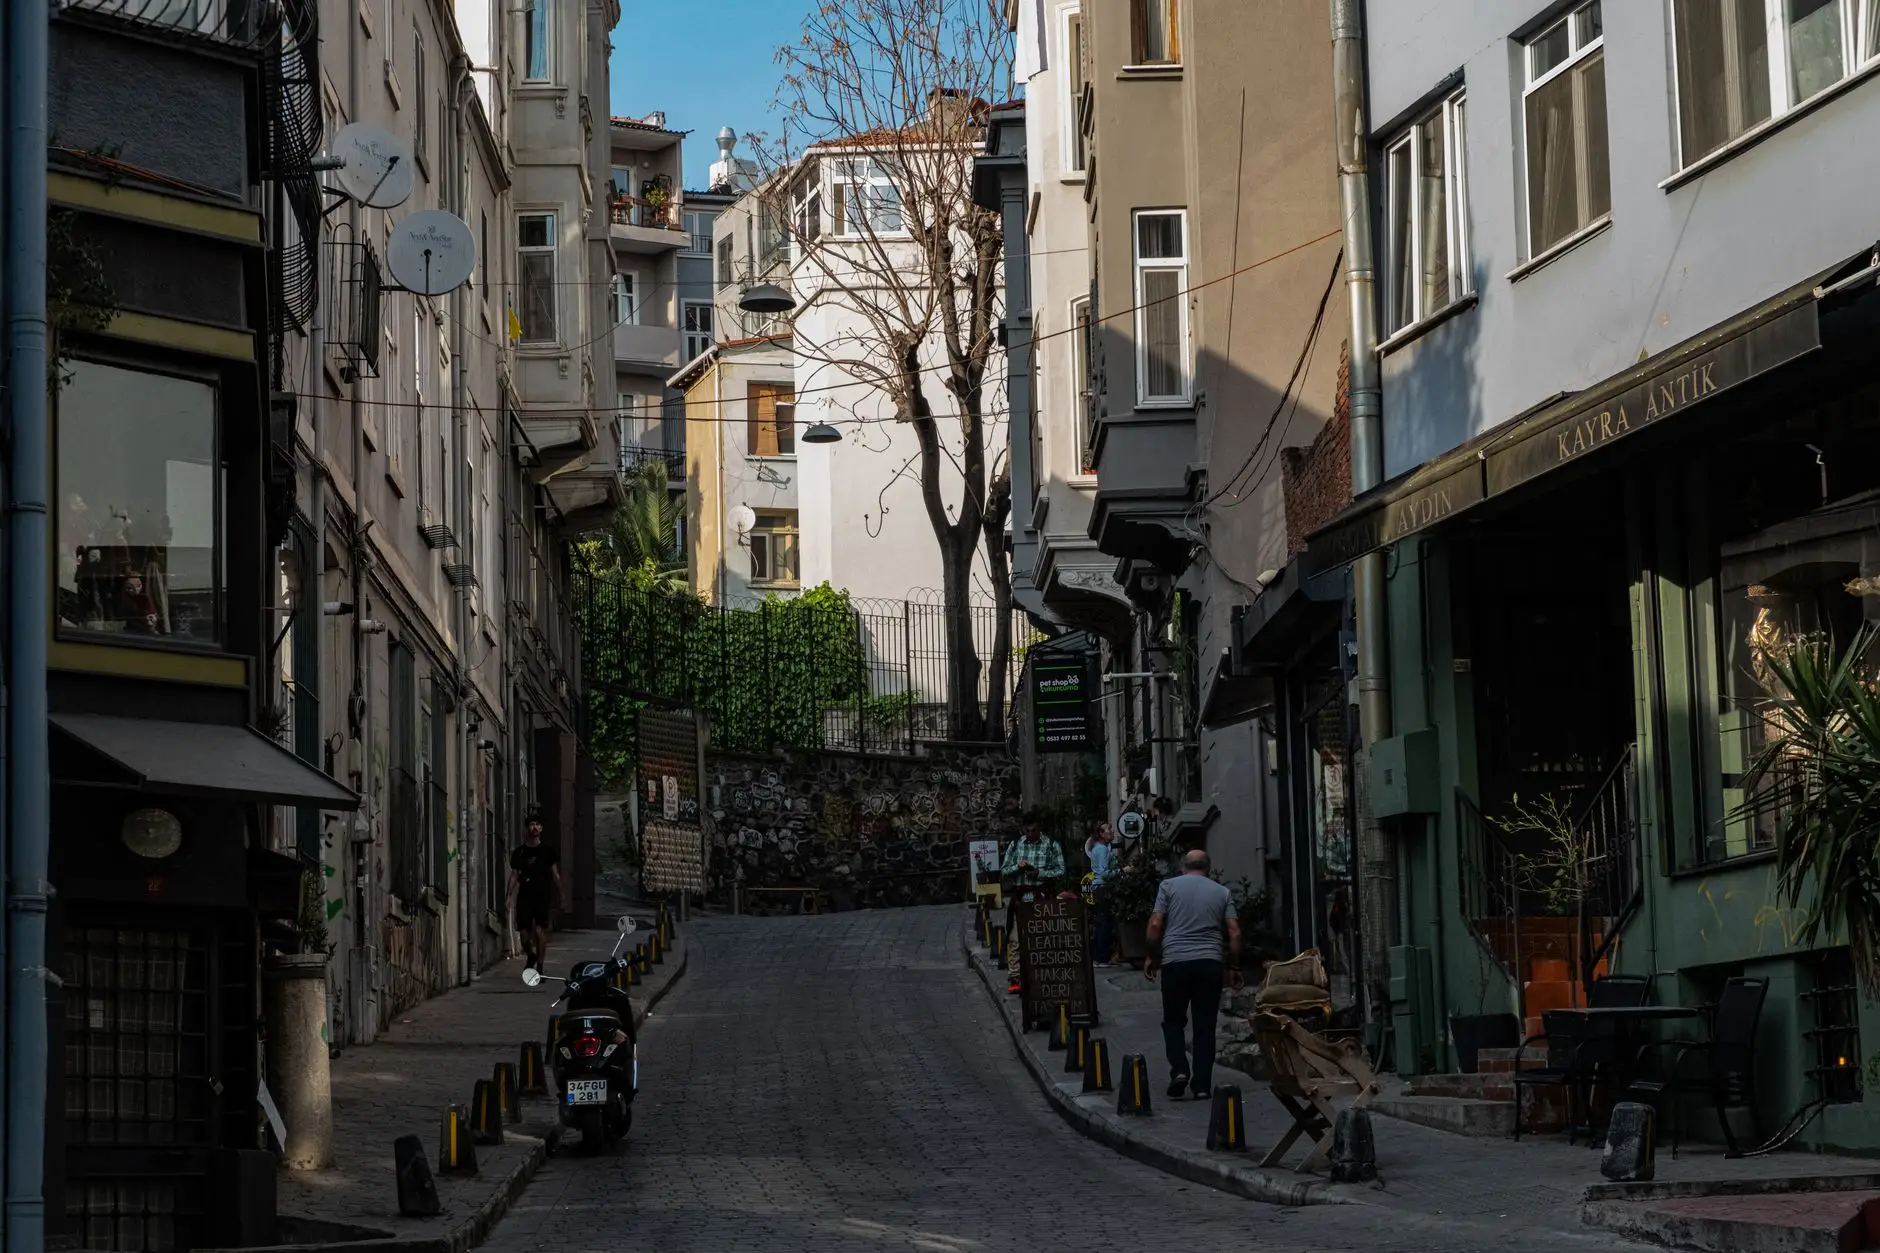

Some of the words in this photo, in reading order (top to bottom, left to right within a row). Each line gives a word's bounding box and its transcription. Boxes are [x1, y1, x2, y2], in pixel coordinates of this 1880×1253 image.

[1398, 489, 1452, 533] AYDIN
[1556, 405, 1630, 462] KAYRA
[1645, 361, 1718, 422] ANTİK
[1039, 680, 1051, 688] pet
[1052, 679, 1069, 687] shop
[1033, 902, 1069, 918] SALE
[1027, 918, 1079, 934] GENUINE
[1027, 934, 1083, 951] LEATHER
[1029, 949, 1082, 966] DESIGNS
[569, 1081, 606, 1091] 34FGU
[579, 1091, 599, 1101] 281
